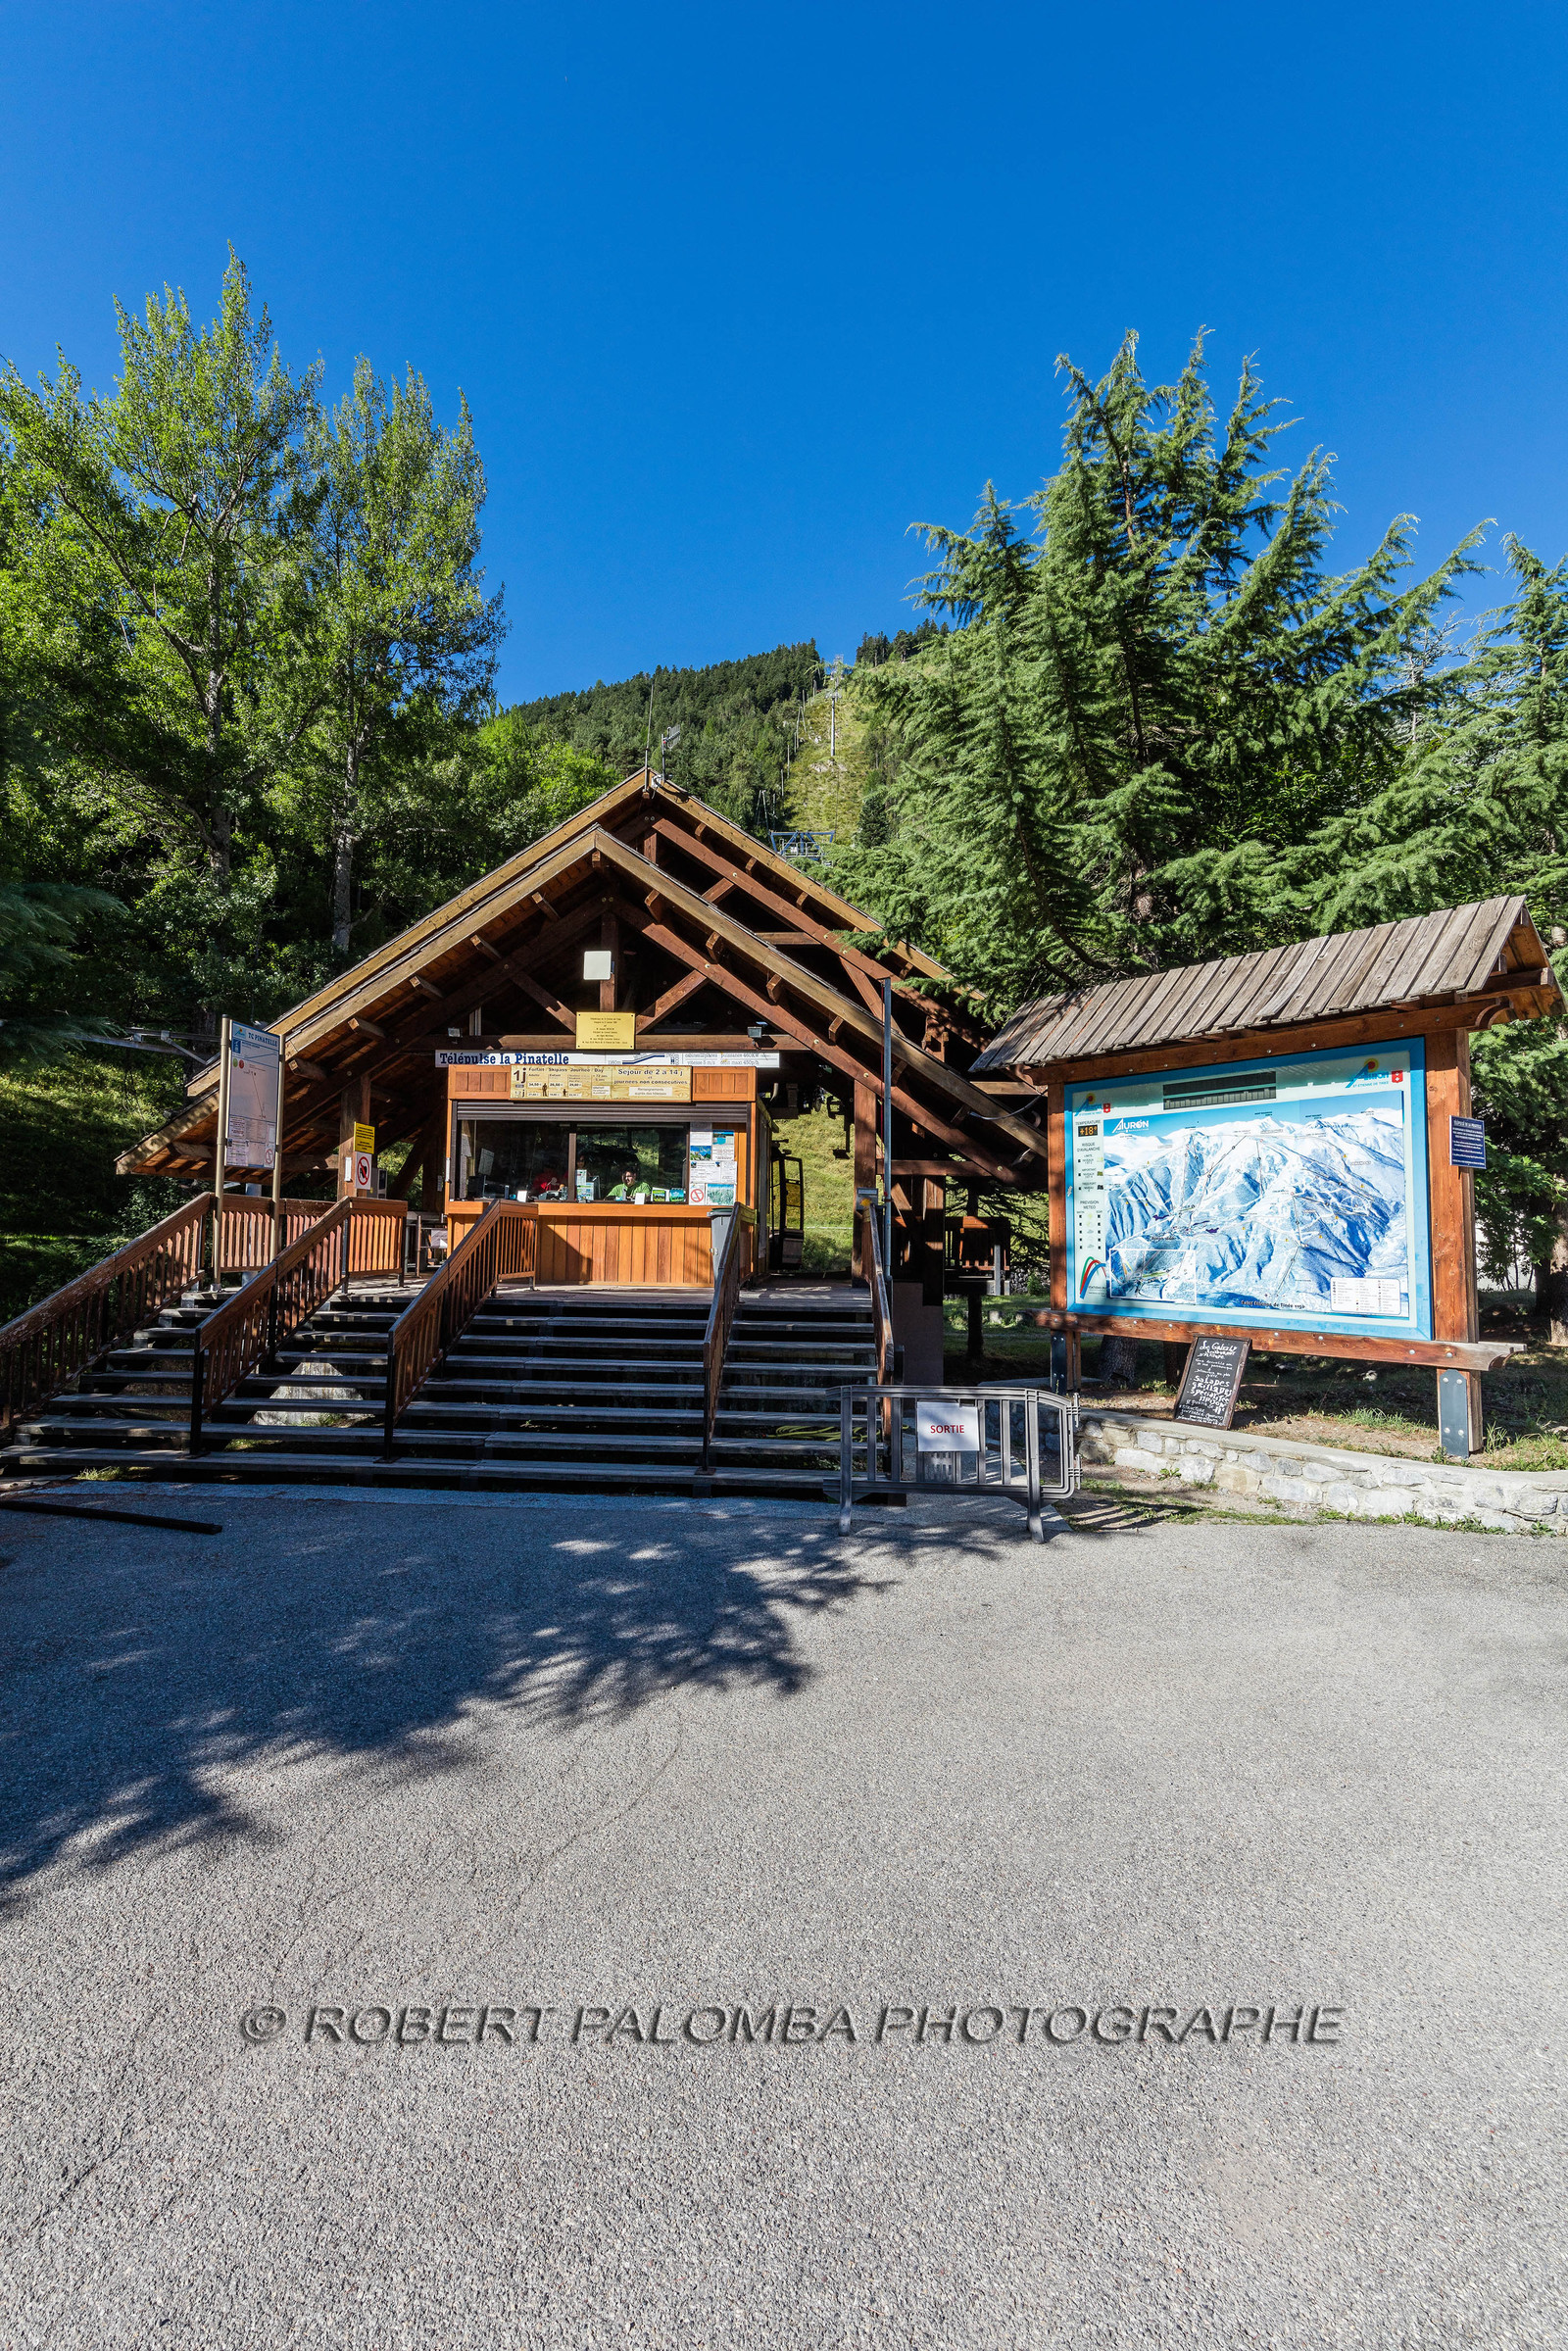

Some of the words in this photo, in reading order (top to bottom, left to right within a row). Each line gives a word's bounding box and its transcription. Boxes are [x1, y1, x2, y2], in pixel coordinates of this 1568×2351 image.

[255, 1034, 278, 1047] PINATELLE
[440, 1053, 495, 1064] Télépulse
[500, 1053, 510, 1064] la
[515, 1053, 569, 1064] Pinatelle
[930, 1425, 965, 1434] SORTIE
